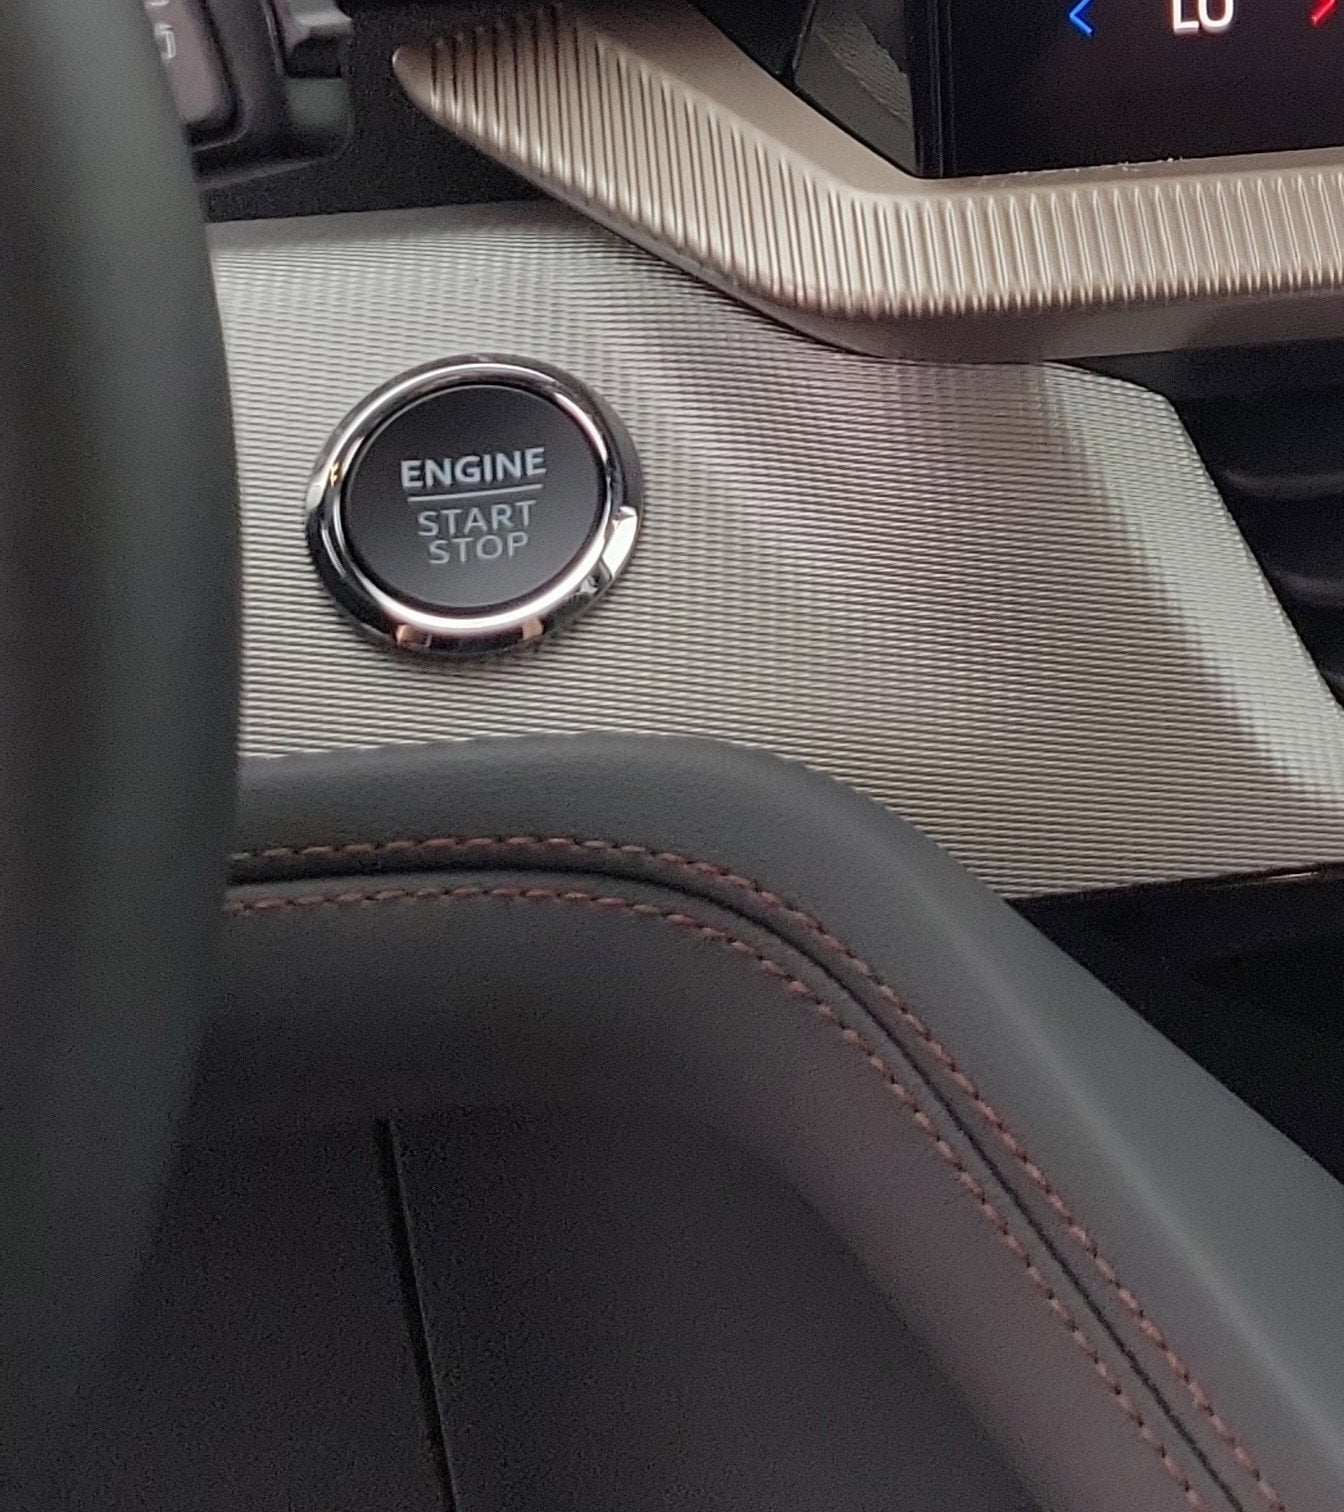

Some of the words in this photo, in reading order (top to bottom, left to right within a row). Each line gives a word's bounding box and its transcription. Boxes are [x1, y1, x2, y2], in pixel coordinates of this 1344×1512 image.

[401, 446, 547, 489] ENGINE
[418, 499, 537, 537] START
[429, 531, 529, 565] STOP
